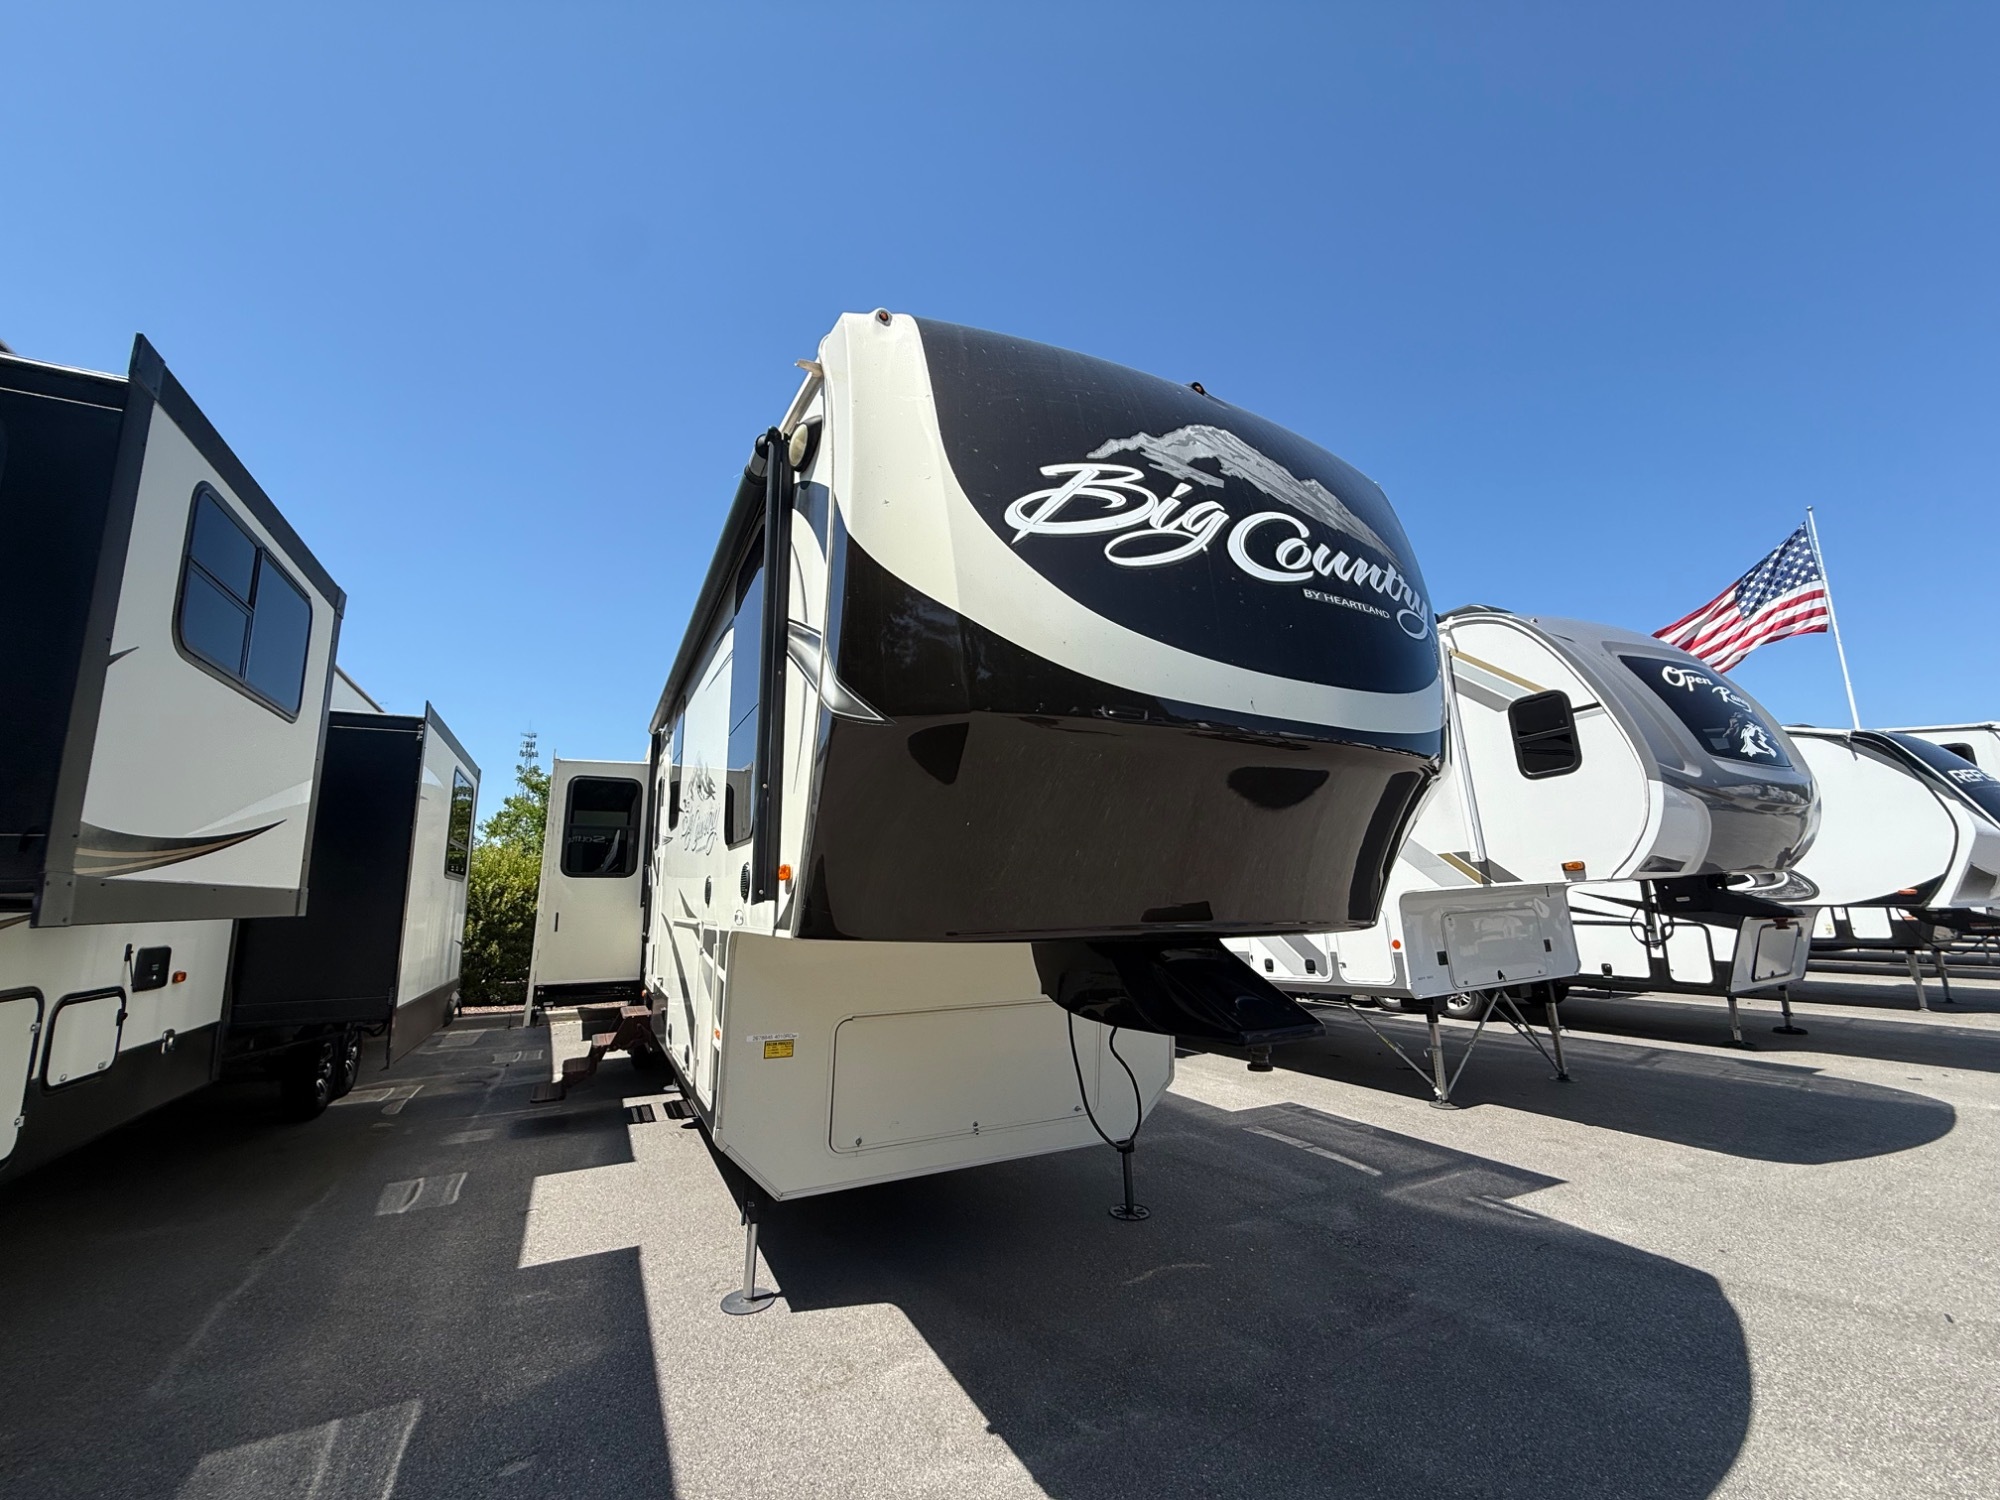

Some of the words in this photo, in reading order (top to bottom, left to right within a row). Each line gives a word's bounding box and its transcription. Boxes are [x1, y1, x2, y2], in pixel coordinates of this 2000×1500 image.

[1004, 463, 1230, 567] Big
[1227, 511, 1432, 641] Country
[1303, 588, 1320, 599] BY
[1324, 593, 1390, 619] HEARTLAND
[1662, 666, 1713, 692] Open
